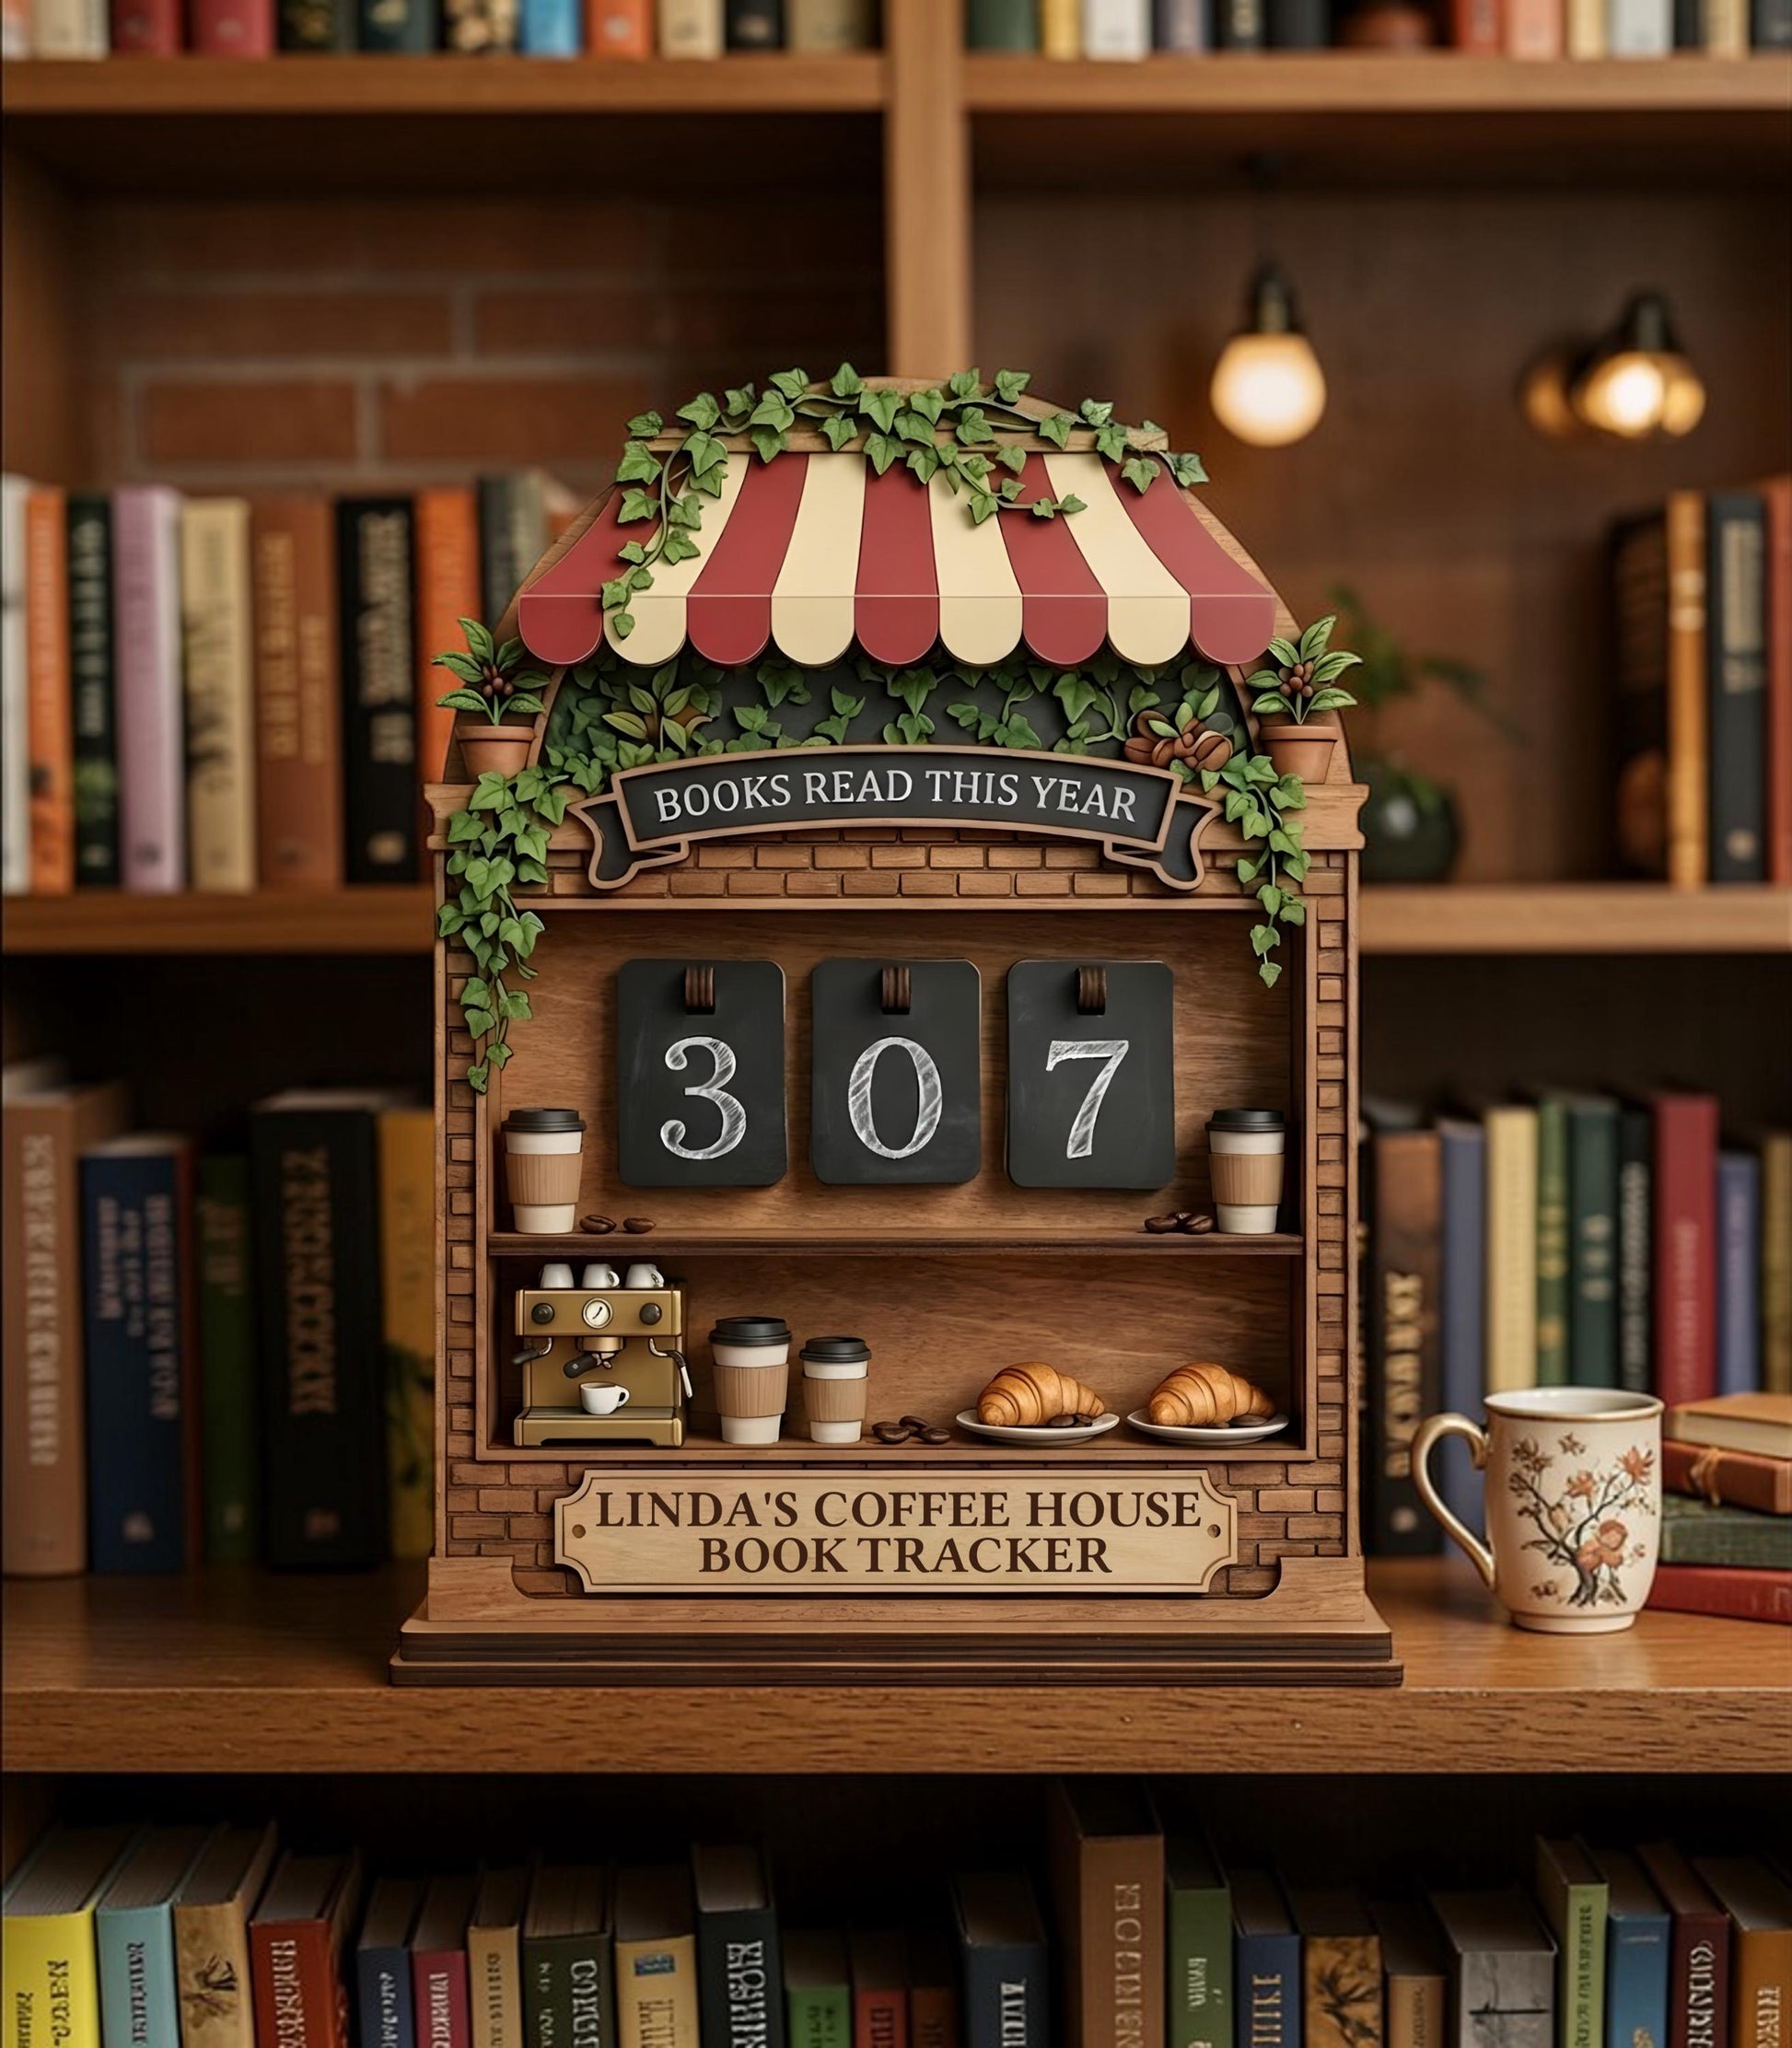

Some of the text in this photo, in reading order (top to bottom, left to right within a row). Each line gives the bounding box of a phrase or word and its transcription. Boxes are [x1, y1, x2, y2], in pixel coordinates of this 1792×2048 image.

[654, 770, 1136, 822] BOOKS READ THIS YEAR
[595, 1492, 1201, 1528] LINDA'S COFFEE HOUSE
[699, 1538, 1111, 1573] BOOK TRACKER
